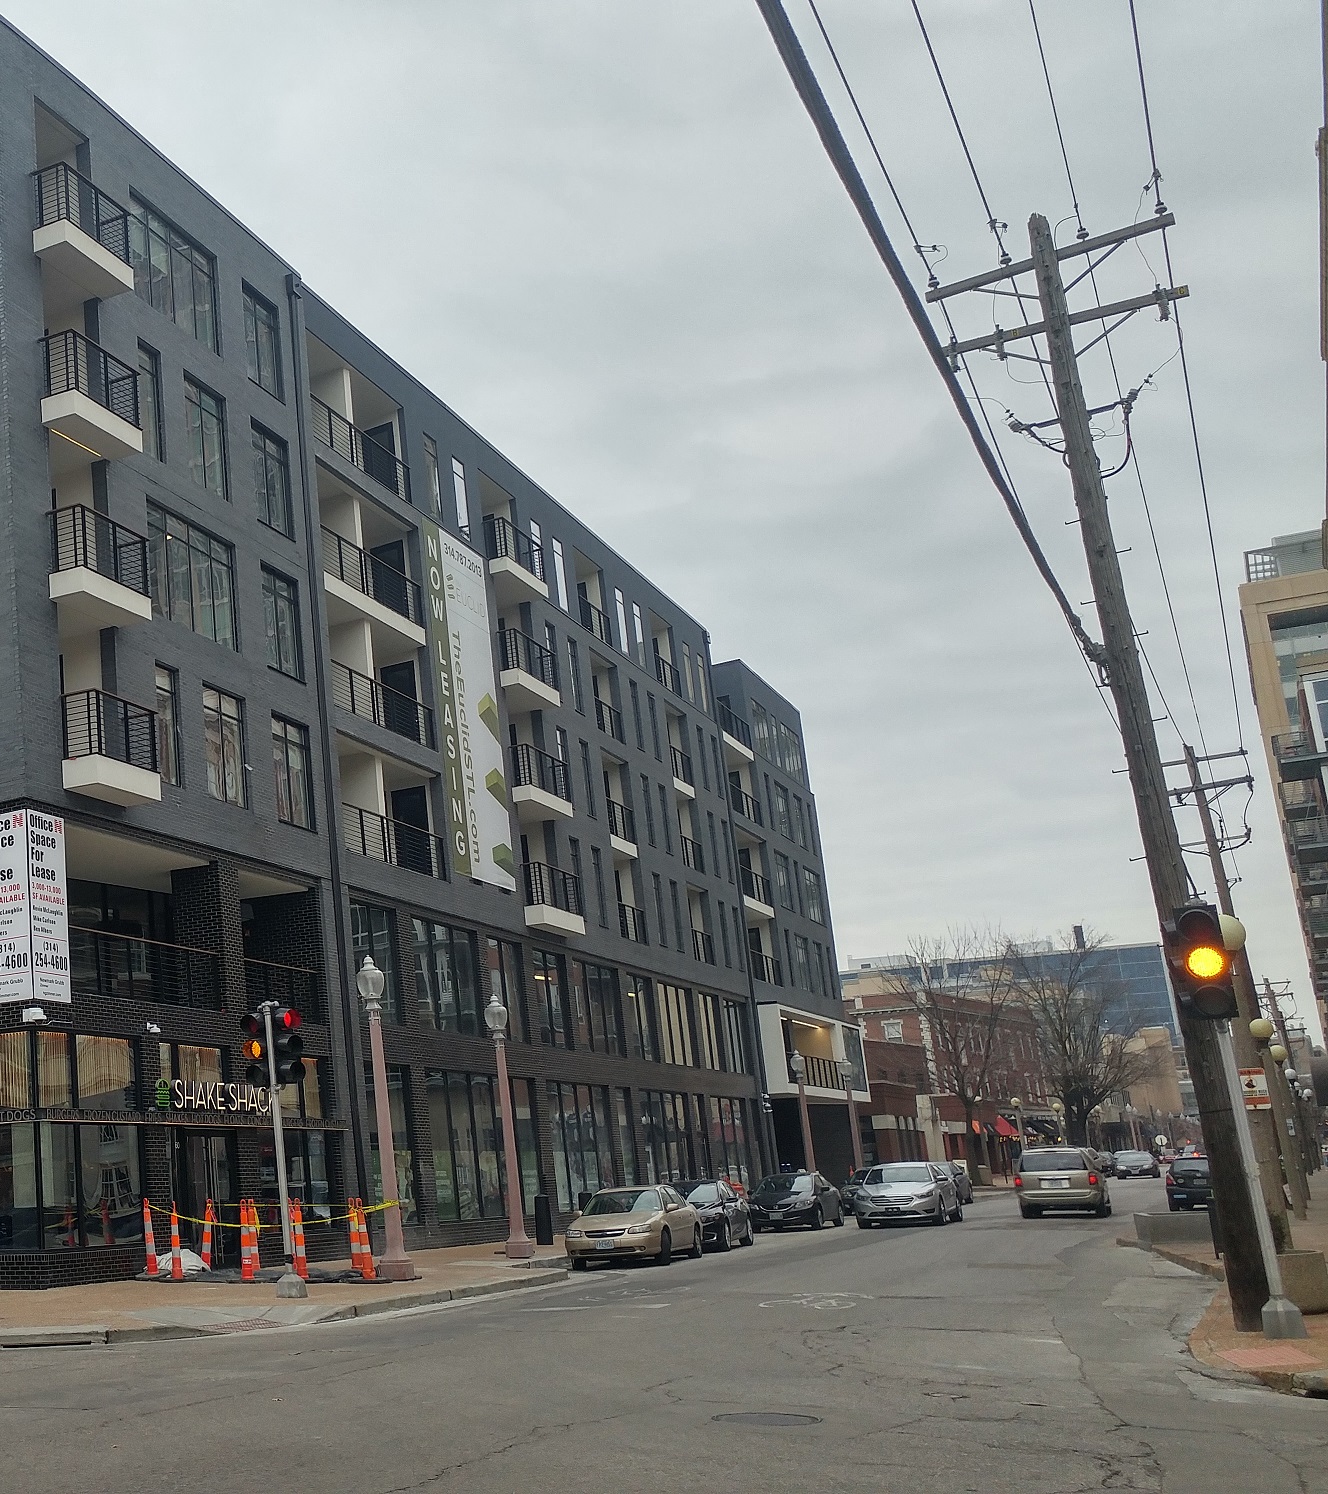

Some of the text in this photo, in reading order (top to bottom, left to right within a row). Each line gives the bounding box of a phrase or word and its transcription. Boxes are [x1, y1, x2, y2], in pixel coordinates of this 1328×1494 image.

[443, 543, 483, 578] 314.787.2013
[427, 535, 466, 857] NOW LEASING
[29, 813, 54, 833] Office
[30, 829, 56, 849] Space
[31, 846, 44, 862] For
[31, 862, 56, 882] Lease
[32, 892, 65, 906] SF AVAILABLE
[43, 940, 59, 953] (314)
[34, 951, 68, 972] 254-4600
[174, 1079, 226, 1111] SHAKE
[46, 1108, 80, 1120] BURGERS
[83, 1110, 112, 1121] FROZEN
[144, 1112, 161, 1122] FRIES
